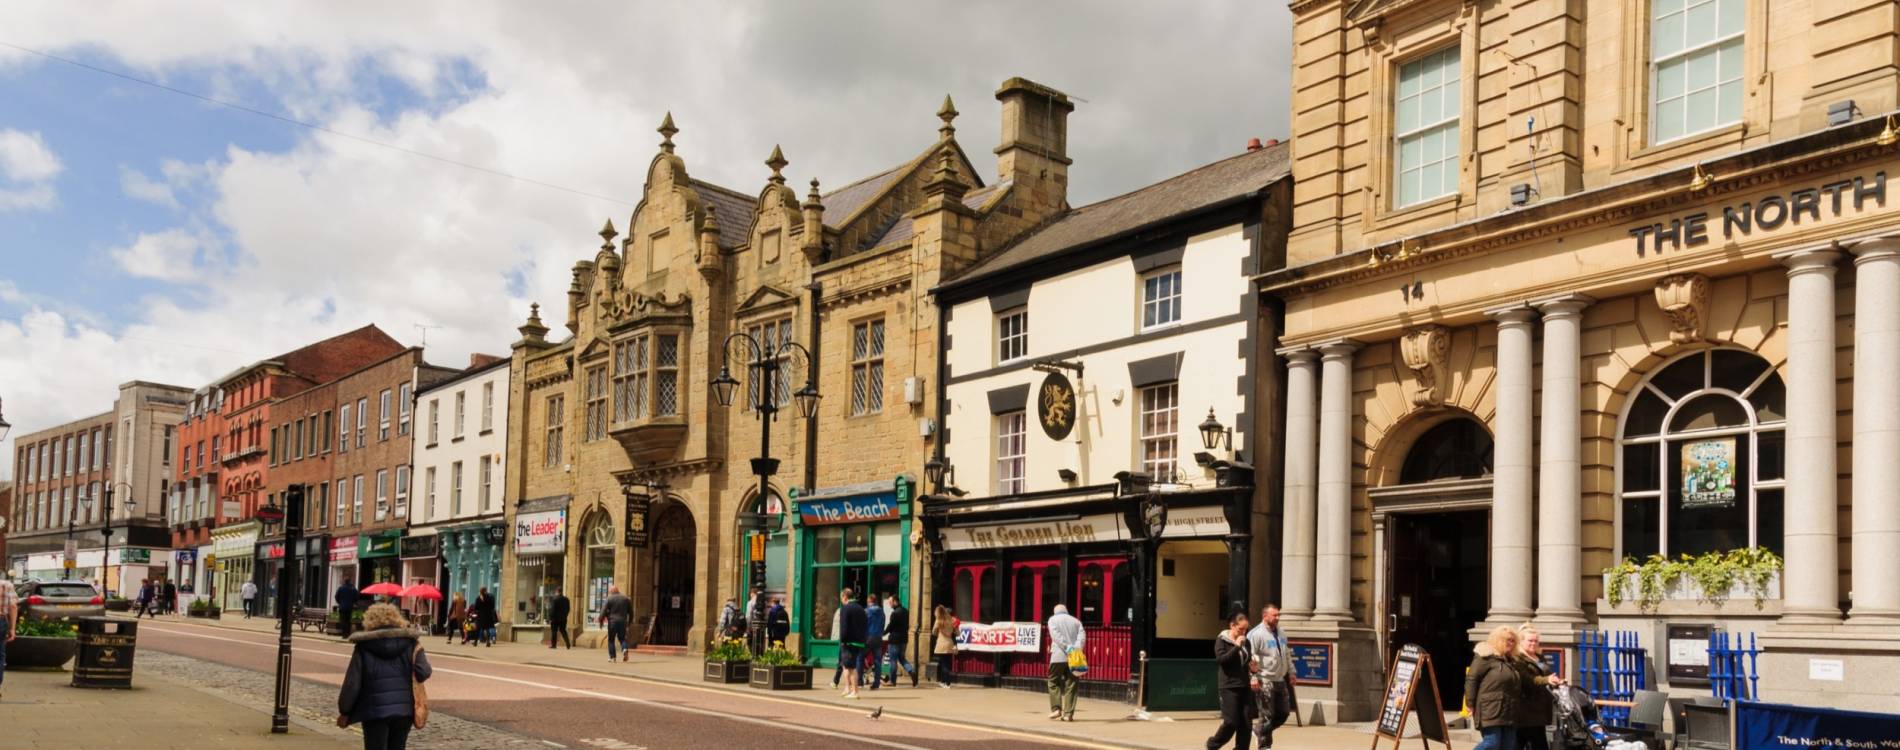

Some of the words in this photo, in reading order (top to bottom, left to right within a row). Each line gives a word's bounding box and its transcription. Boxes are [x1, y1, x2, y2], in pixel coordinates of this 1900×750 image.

[1628, 212, 1709, 258] THE
[1722, 170, 1887, 240] NORTH
[1400, 280, 1424, 304] 14
[811, 502, 841, 522] The
[843, 497, 891, 521] Beach
[517, 520, 531, 537] the
[531, 517, 559, 536] Leader
[1174, 518, 1194, 527] HIGH
[1195, 516, 1224, 525] STREET
[970, 629, 1015, 644] SPORTS
[1018, 627, 1036, 637] LIVE
[1017, 637, 1036, 646] HERE
[1777, 735, 1798, 745] The
[1800, 737, 1832, 747] North
[1834, 738, 1843, 746] &
[1846, 739, 1878, 749] South
